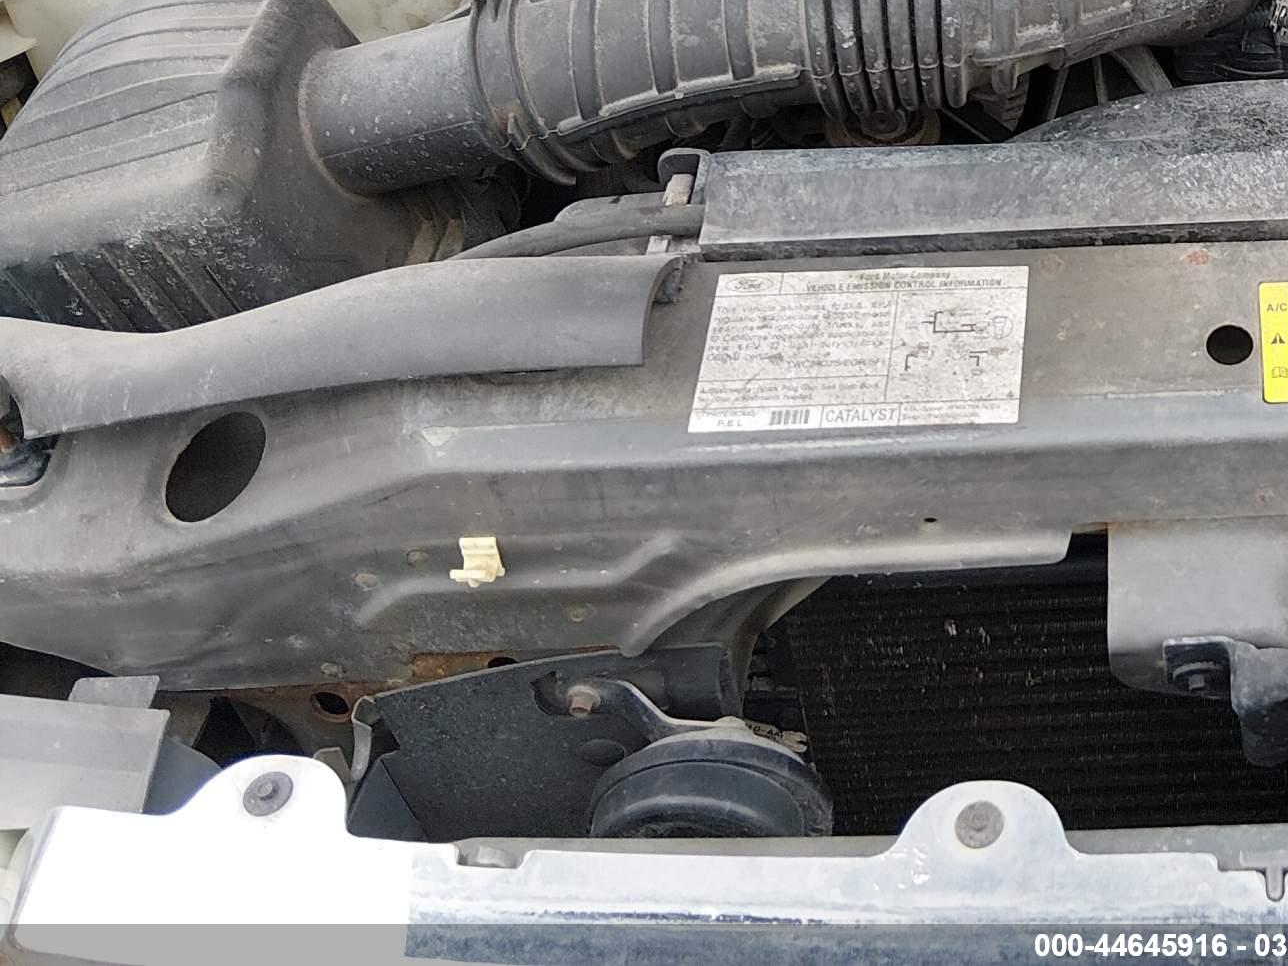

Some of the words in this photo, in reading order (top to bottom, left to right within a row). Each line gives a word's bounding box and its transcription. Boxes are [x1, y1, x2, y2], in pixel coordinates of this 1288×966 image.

[846, 281, 892, 292] EMISSION
[894, 280, 937, 290] CONTROL
[938, 278, 1002, 288] INFORMATION
[1266, 303, 1288, 312] A/C
[825, 408, 897, 423] CATALYST
